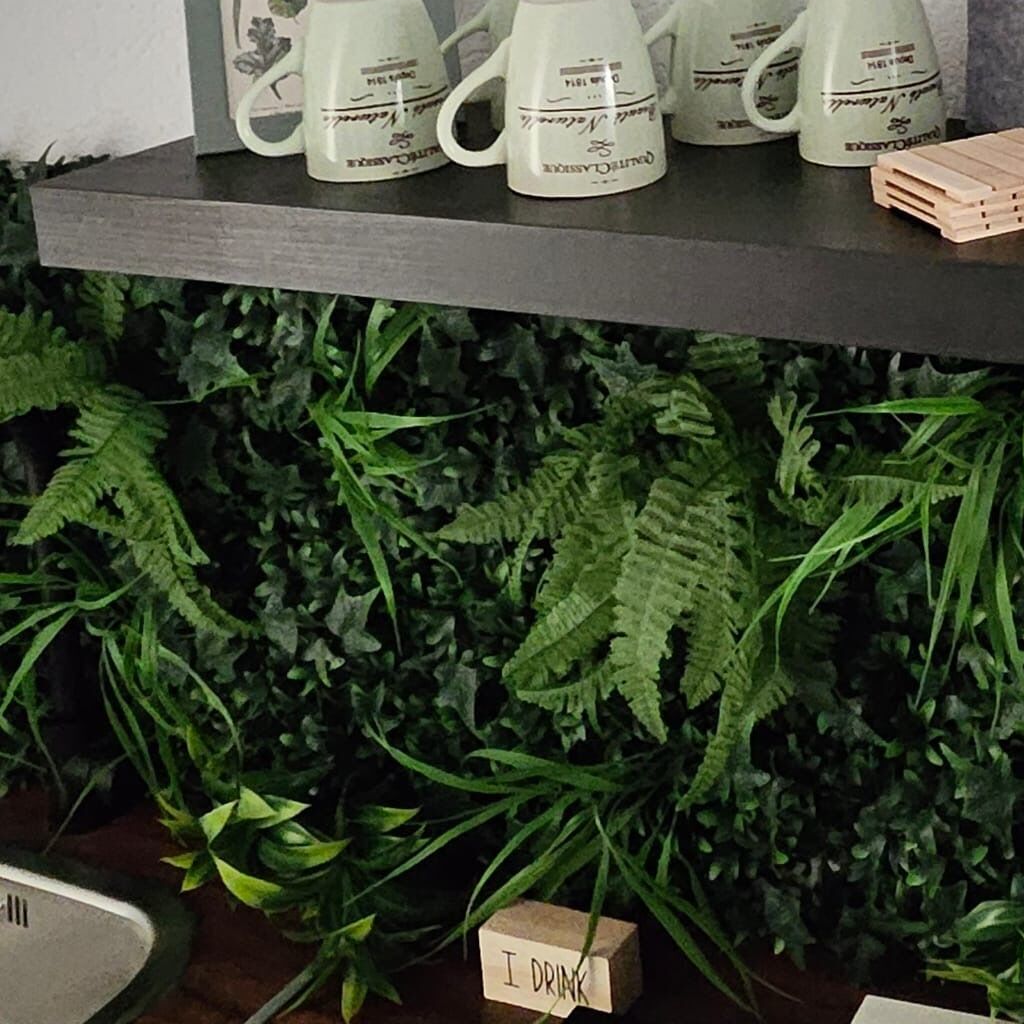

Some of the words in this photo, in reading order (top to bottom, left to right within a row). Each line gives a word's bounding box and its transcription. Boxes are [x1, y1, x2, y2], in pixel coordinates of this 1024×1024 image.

[565, 77, 587, 88] 1814
[502, 949, 520, 989] I
[531, 958, 590, 1006] DRINK
